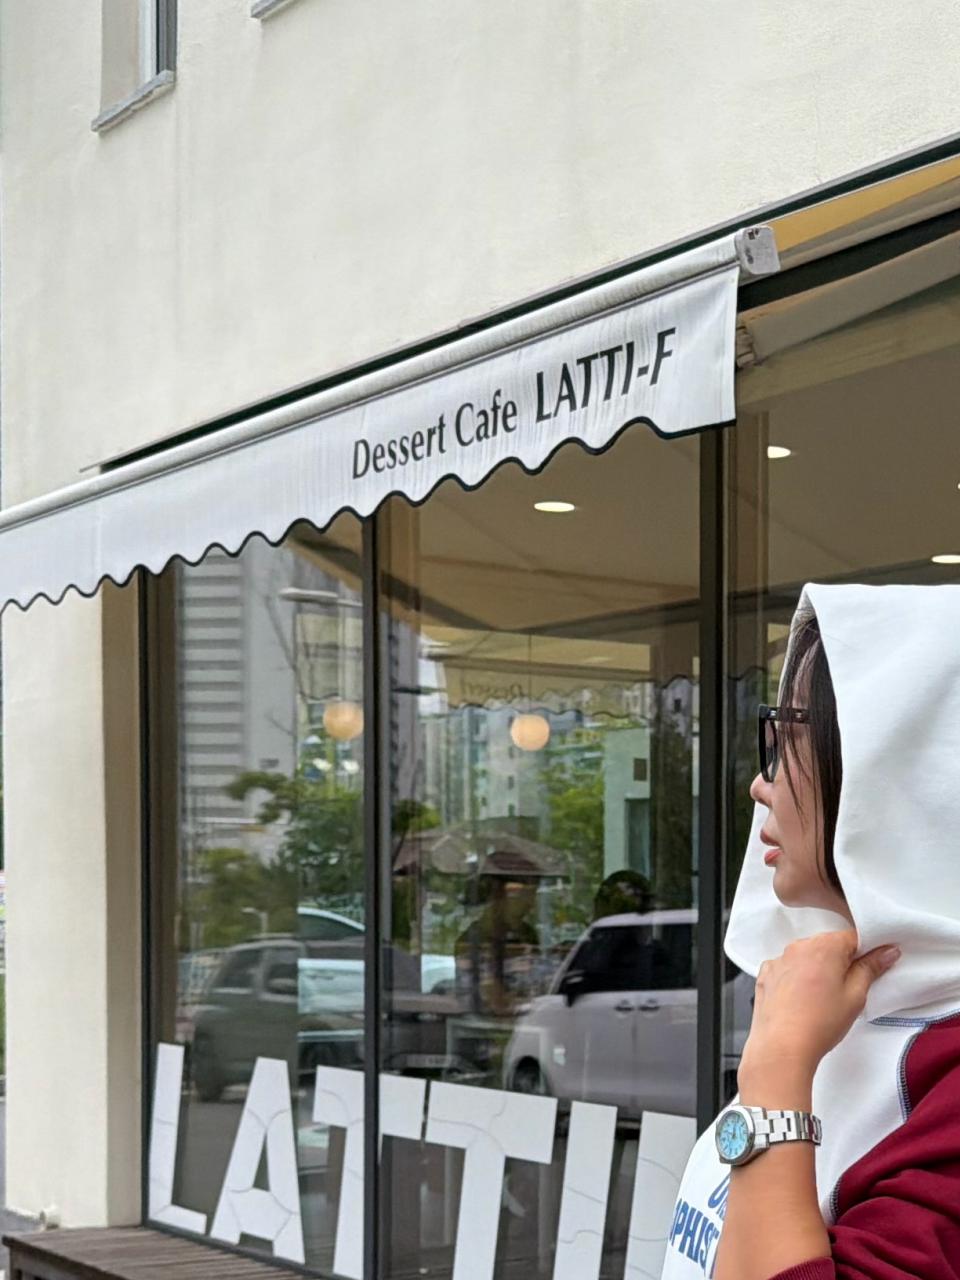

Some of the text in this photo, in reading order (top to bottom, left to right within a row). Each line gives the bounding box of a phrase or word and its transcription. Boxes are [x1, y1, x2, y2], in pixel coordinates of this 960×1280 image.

[352, 326, 677, 480] Dessert Cafe LATTI-F
